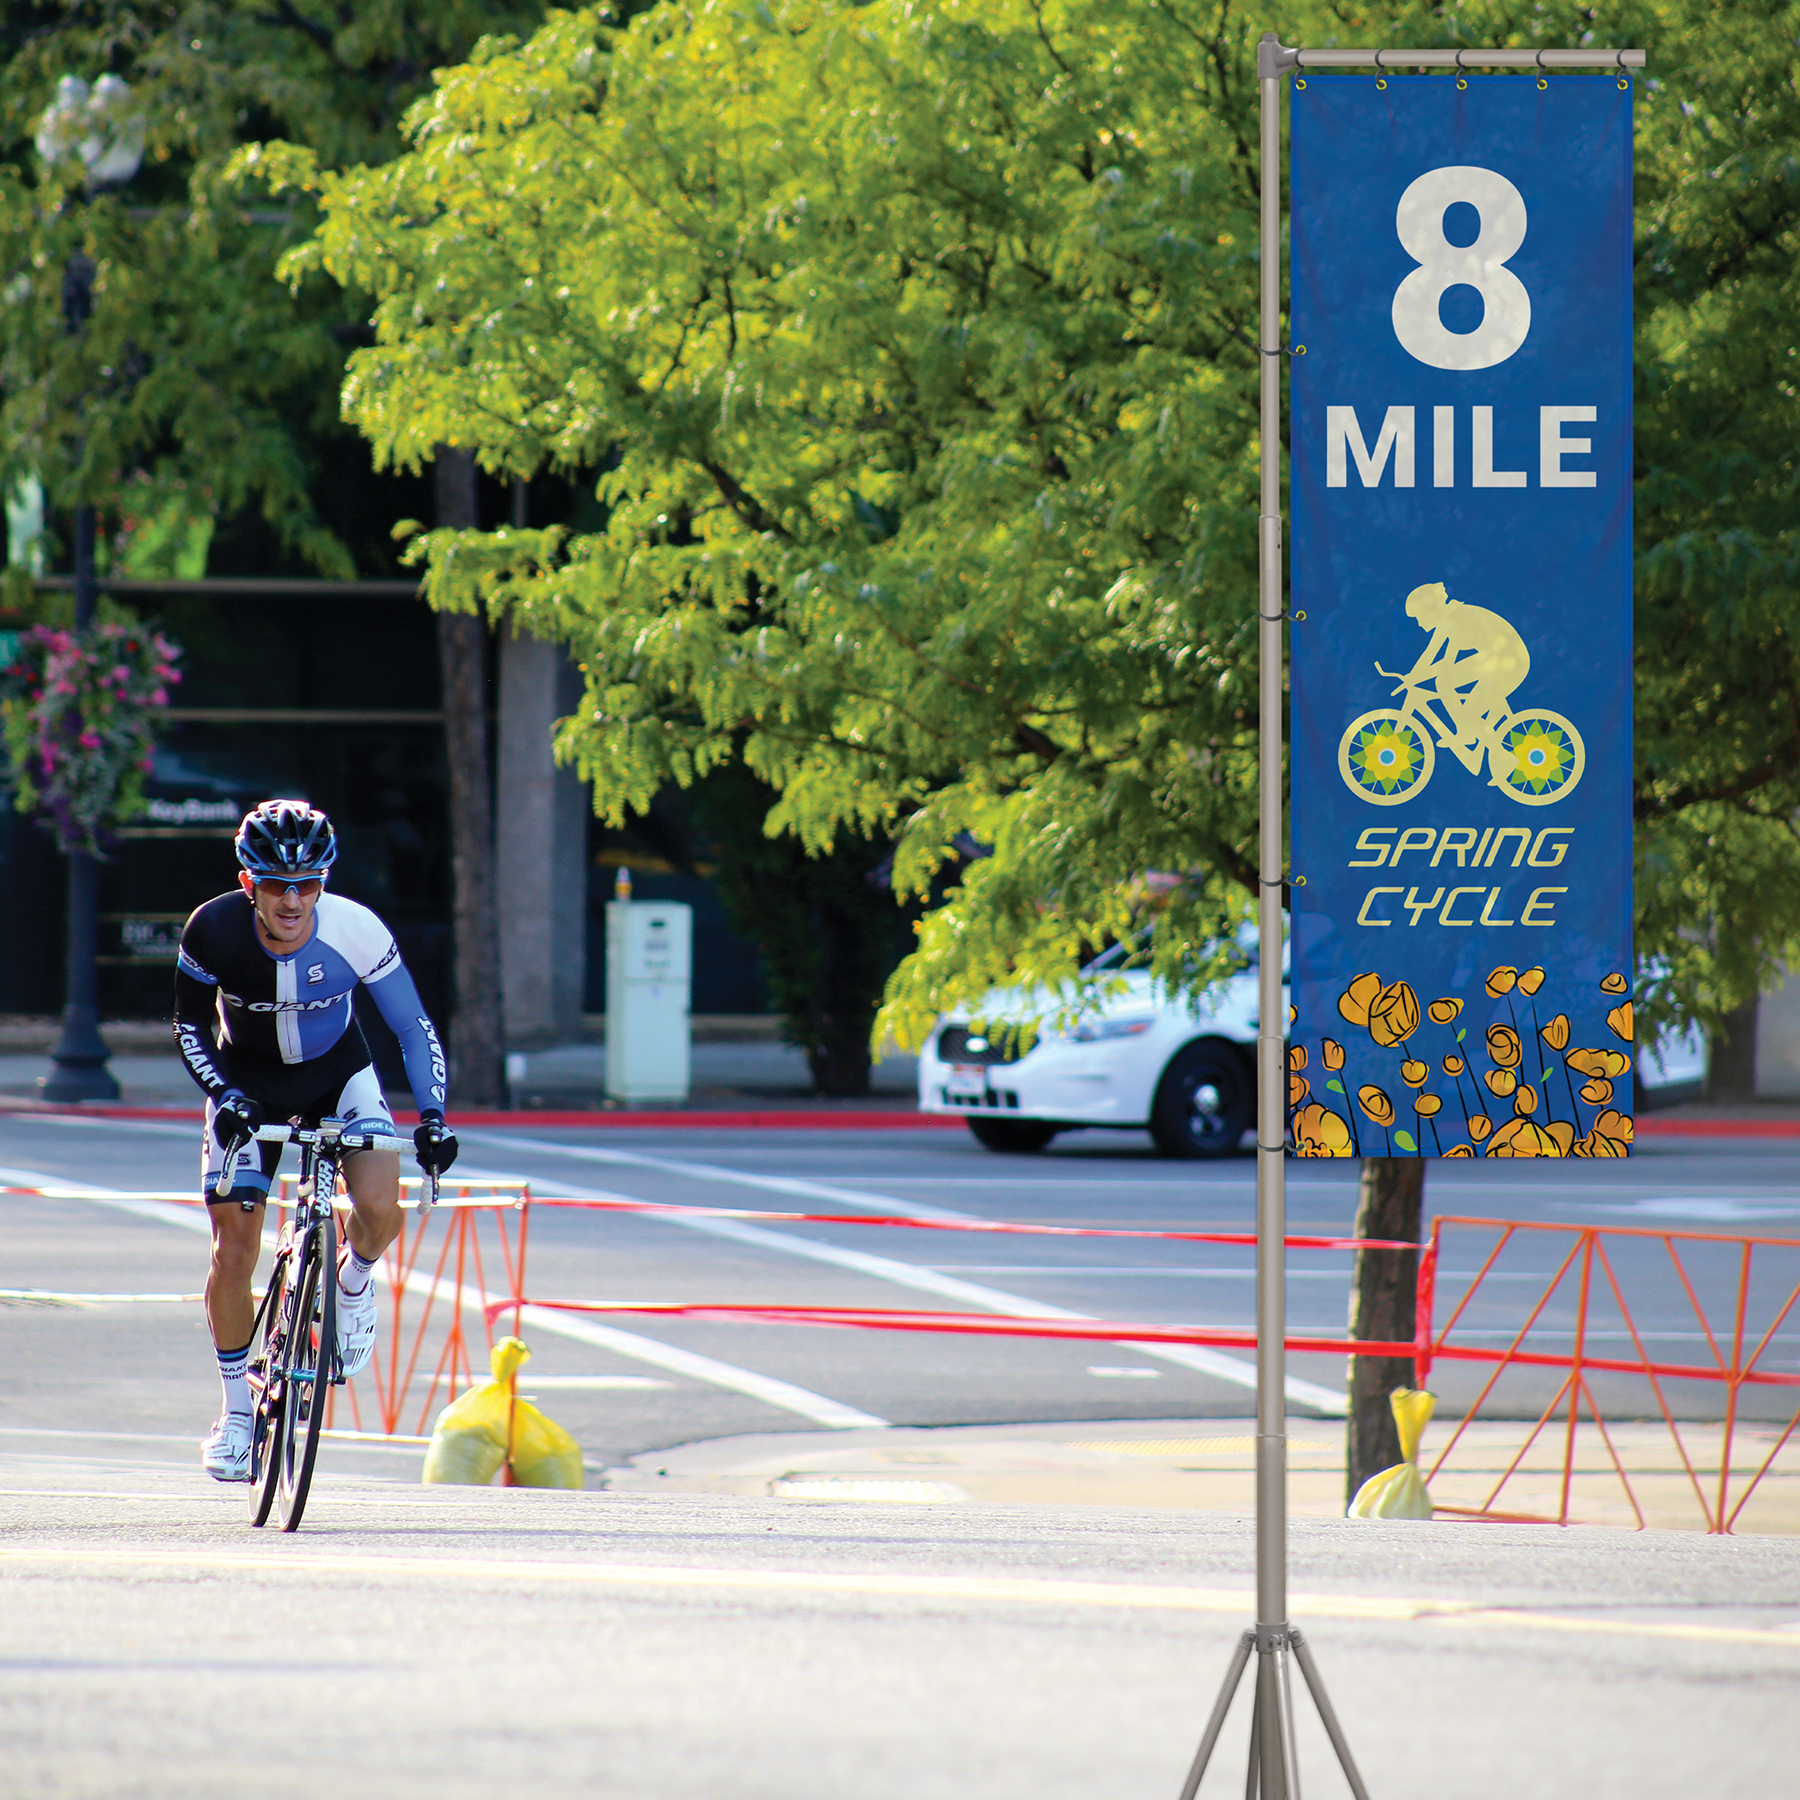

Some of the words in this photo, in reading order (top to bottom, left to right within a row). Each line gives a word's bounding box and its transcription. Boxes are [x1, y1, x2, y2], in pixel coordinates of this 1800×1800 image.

[1392, 166, 1531, 370] 8
[1327, 405, 1597, 488] MILE
[148, 798, 238, 823] KeyBank
[1348, 828, 1575, 867] SPRING
[1357, 887, 1569, 926] CYCLE
[247, 991, 346, 1012] GIANT
[180, 1034, 225, 1088] GIANT
[418, 1017, 446, 1085] GIANT
[360, 1122, 384, 1130] RIDE
[315, 1160, 328, 1215] GIANT
